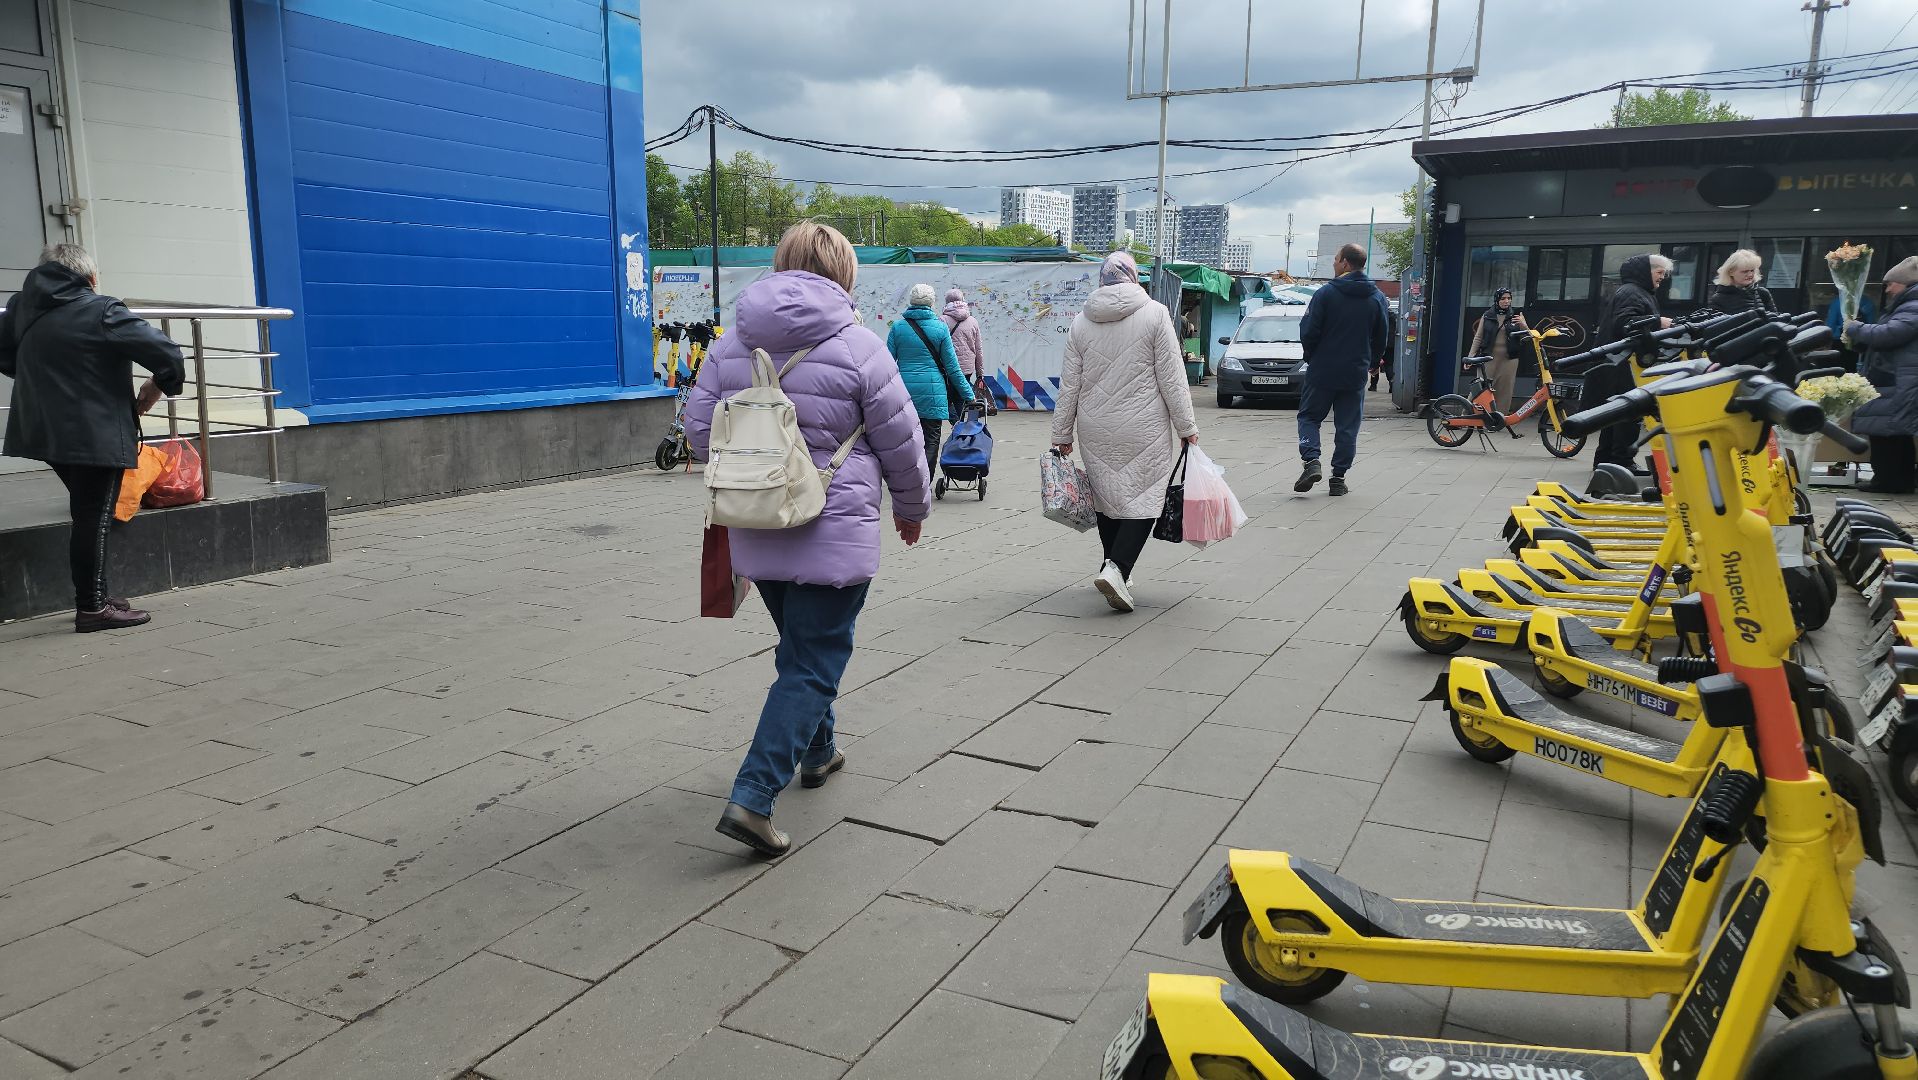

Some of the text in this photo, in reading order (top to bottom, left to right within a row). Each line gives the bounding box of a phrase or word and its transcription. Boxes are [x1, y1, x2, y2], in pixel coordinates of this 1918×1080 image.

[1778, 172, 1916, 191] ВЫПЕЧКА
[1742, 478, 1756, 494] Go
[1649, 575, 1662, 592] ВТБ
[1721, 551, 1762, 643] Яндекс Go
[1481, 628, 1497, 636] ВТБ
[1641, 693, 1668, 712] ВЕЗЁТ
[1535, 736, 1603, 774] НО078К
[1425, 913, 1588, 934] Яндекс Go
[1388, 1055, 1446, 1080] Go
